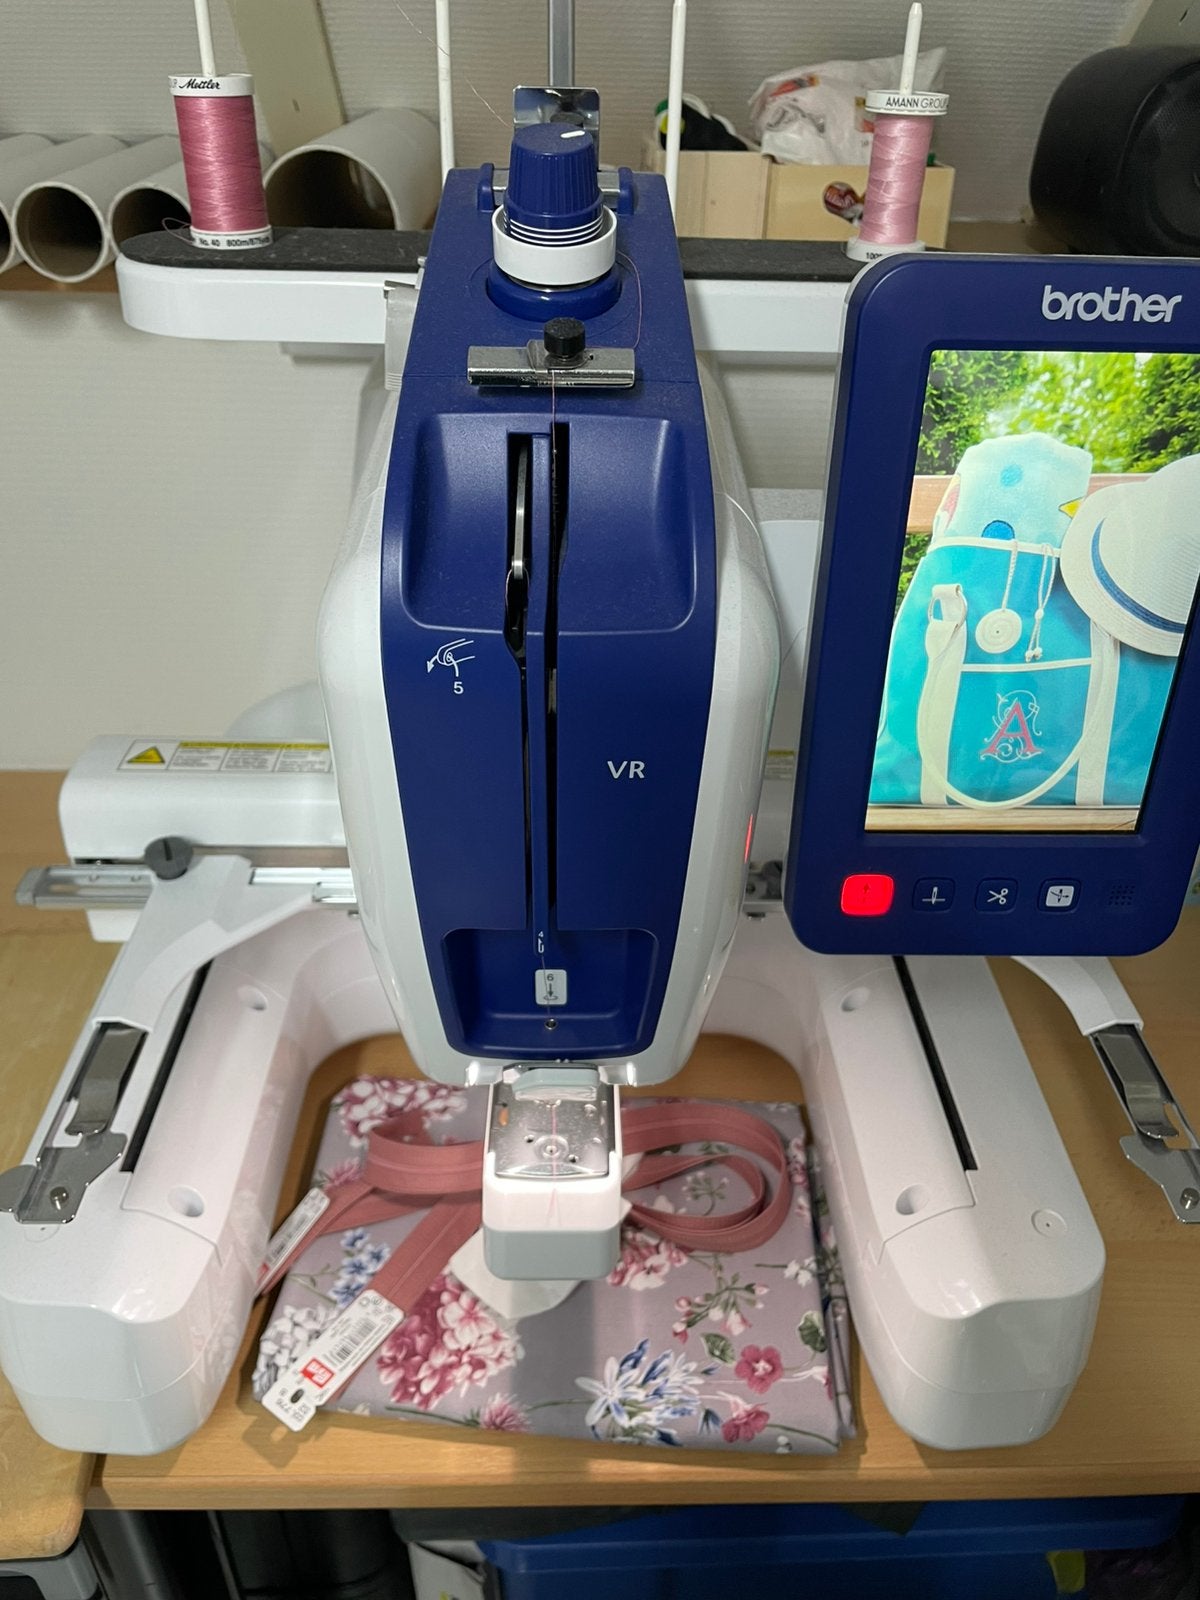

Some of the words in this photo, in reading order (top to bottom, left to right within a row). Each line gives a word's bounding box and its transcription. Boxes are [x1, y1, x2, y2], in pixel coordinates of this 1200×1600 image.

[178, 78, 221, 90] Mettler
[886, 96, 919, 108] AMANN
[211, 239, 220, 247] 40
[1041, 285, 1183, 322] brother
[453, 681, 464, 695] 5
[980, 697, 1042, 758] A
[607, 760, 646, 779] VR
[546, 973, 555, 982] 6
